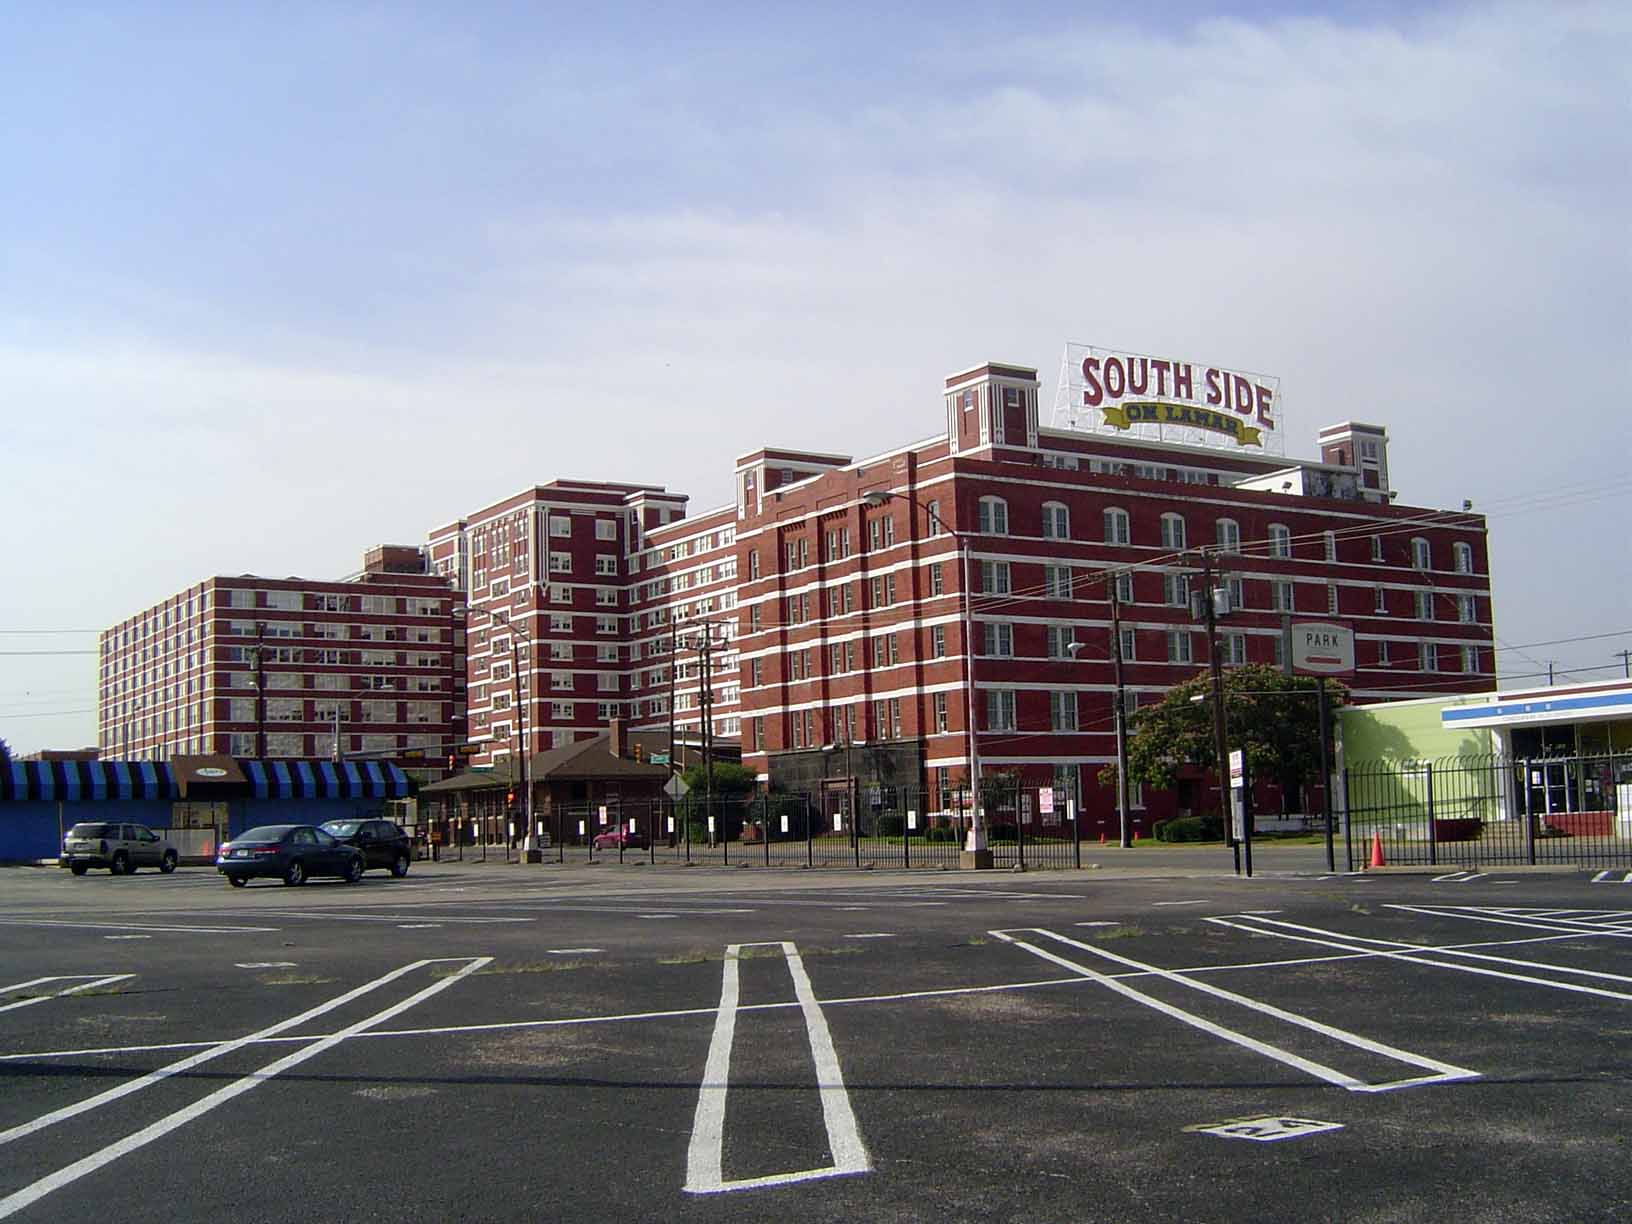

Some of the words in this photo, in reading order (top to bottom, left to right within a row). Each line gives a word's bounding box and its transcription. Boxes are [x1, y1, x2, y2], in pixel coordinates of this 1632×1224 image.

[1082, 356, 1193, 407] SOUTH
[1205, 367, 1275, 431] SIDE
[1127, 404, 1157, 421] ON
[1306, 632, 1338, 648] PARK
